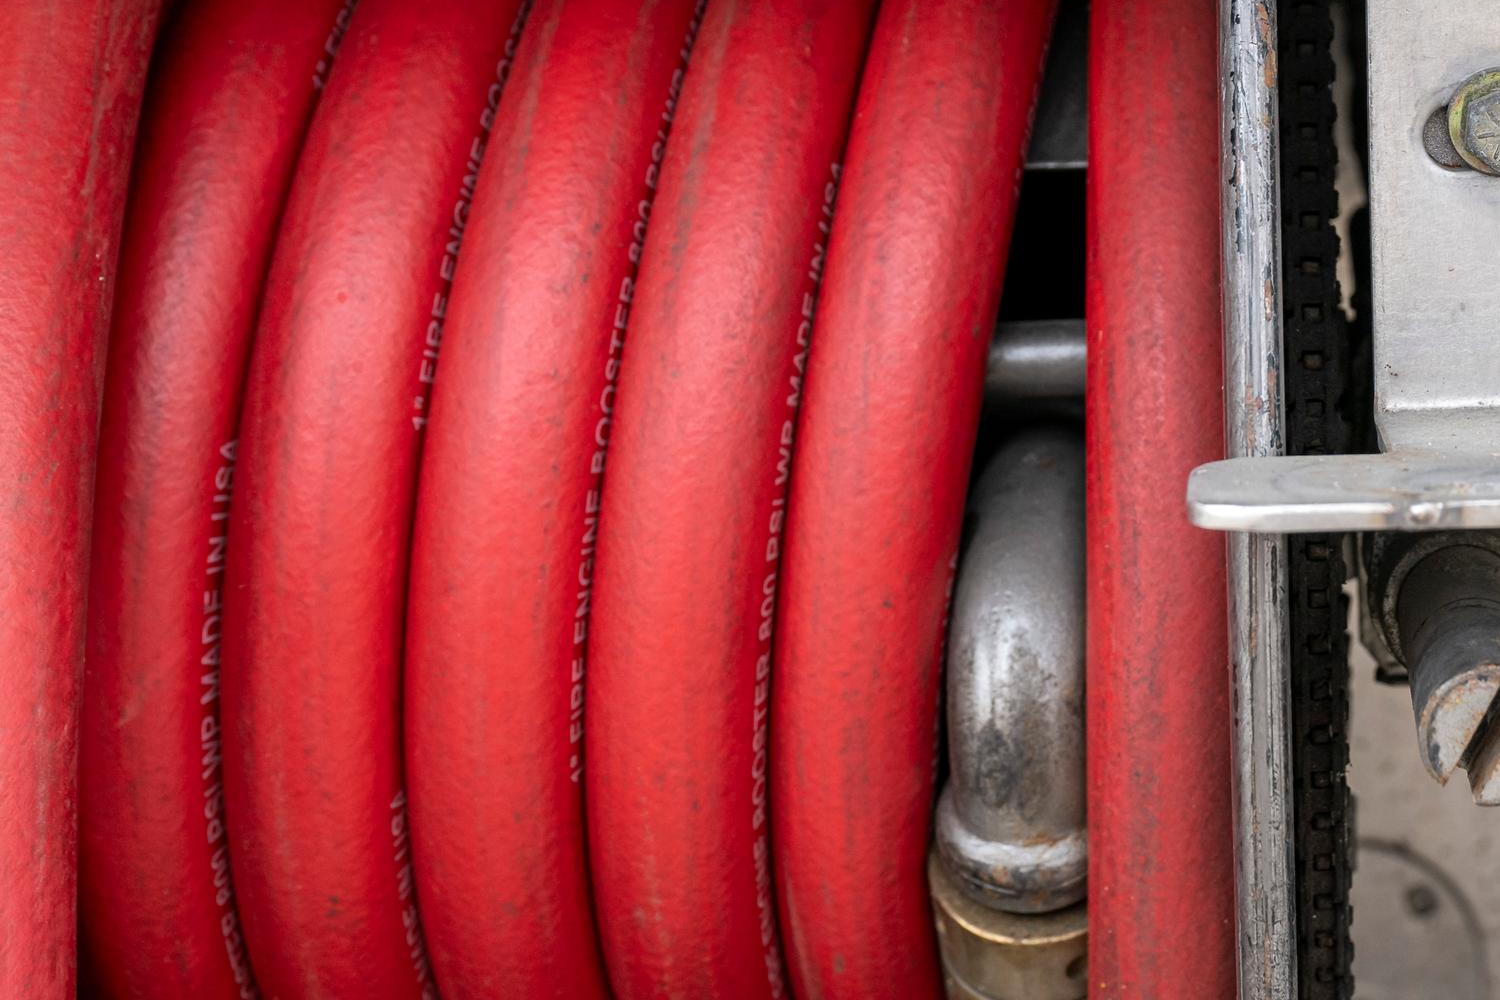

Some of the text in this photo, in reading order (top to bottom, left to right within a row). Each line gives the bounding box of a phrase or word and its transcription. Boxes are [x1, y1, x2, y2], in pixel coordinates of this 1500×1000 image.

[418, 292, 448, 384] FIRE
[211, 438, 240, 522] USA
[206, 533, 227, 576] IN
[200, 589, 222, 705] MADE
